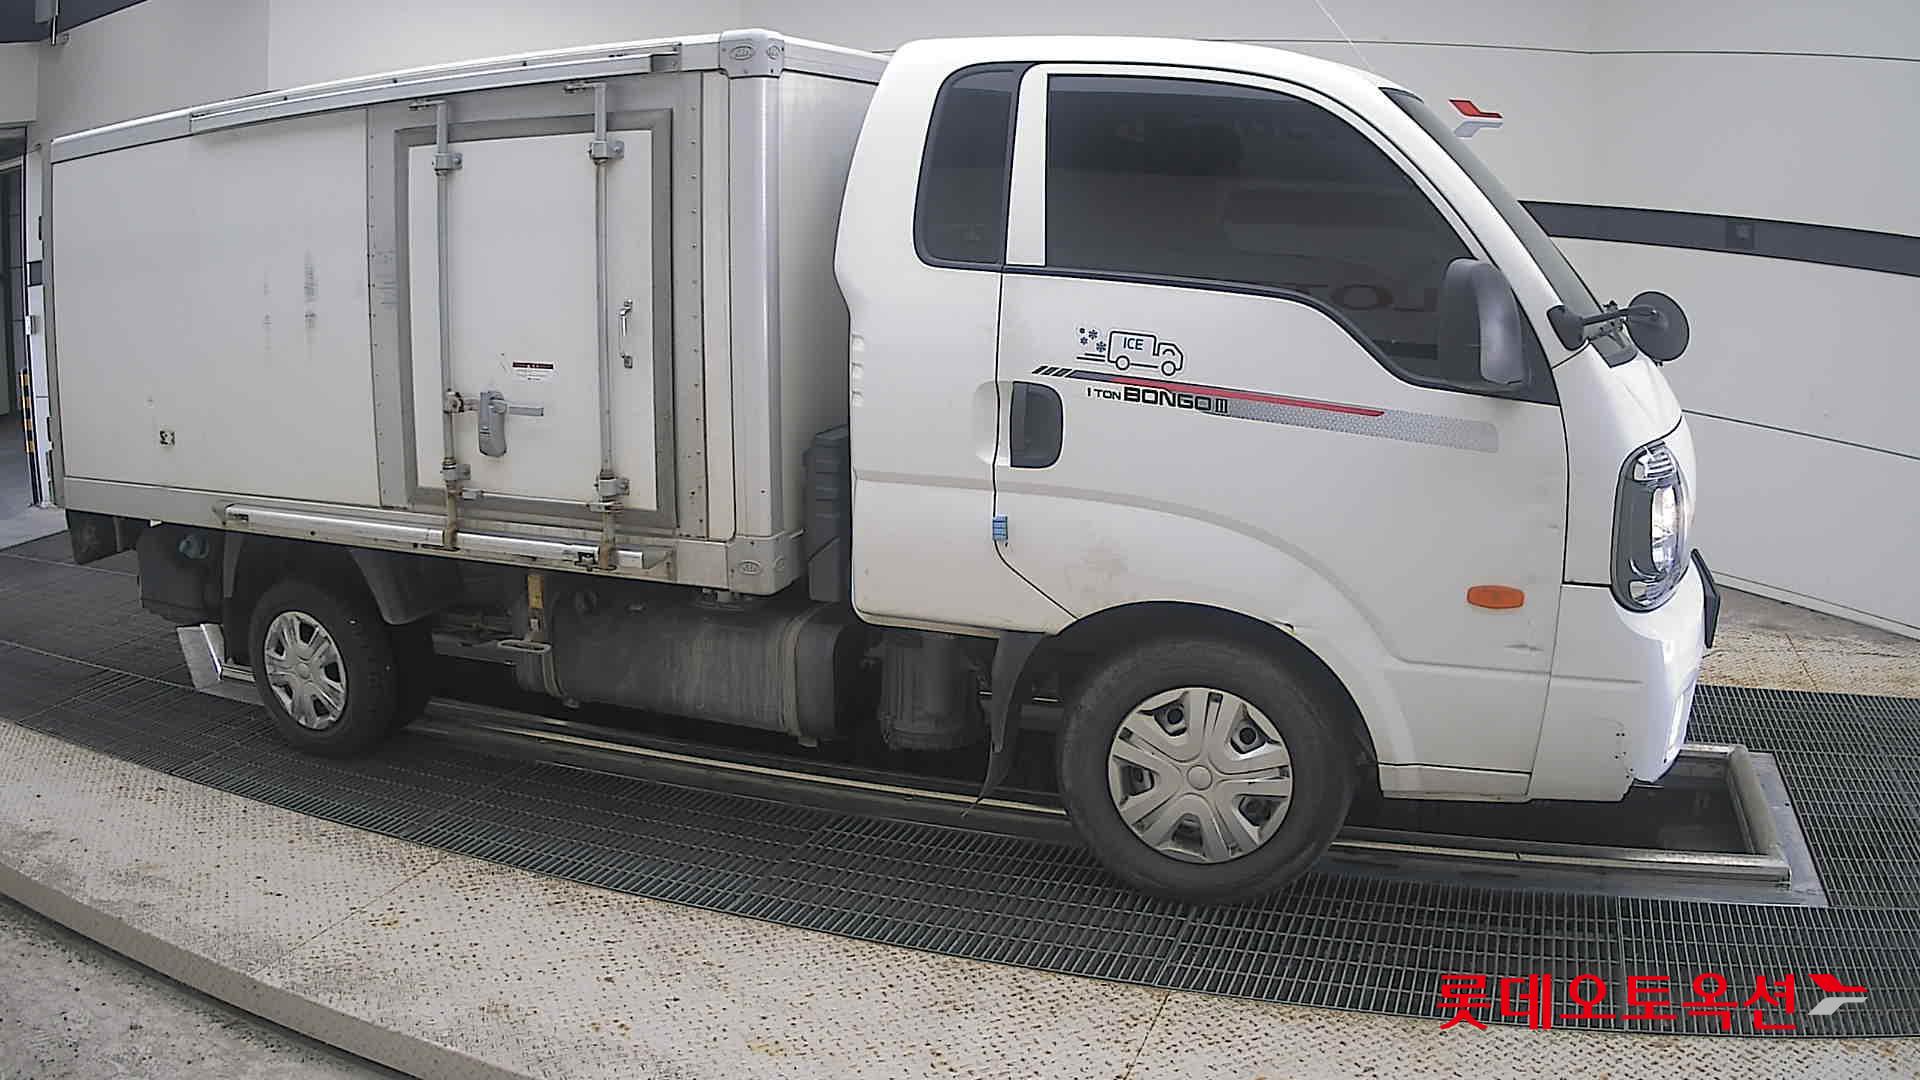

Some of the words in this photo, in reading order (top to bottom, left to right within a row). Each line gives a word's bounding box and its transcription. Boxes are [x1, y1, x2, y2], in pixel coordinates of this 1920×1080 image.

[1123, 337, 1144, 350] ICE
[1094, 388, 1121, 400] TON
[1123, 386, 1212, 411] BONGO
